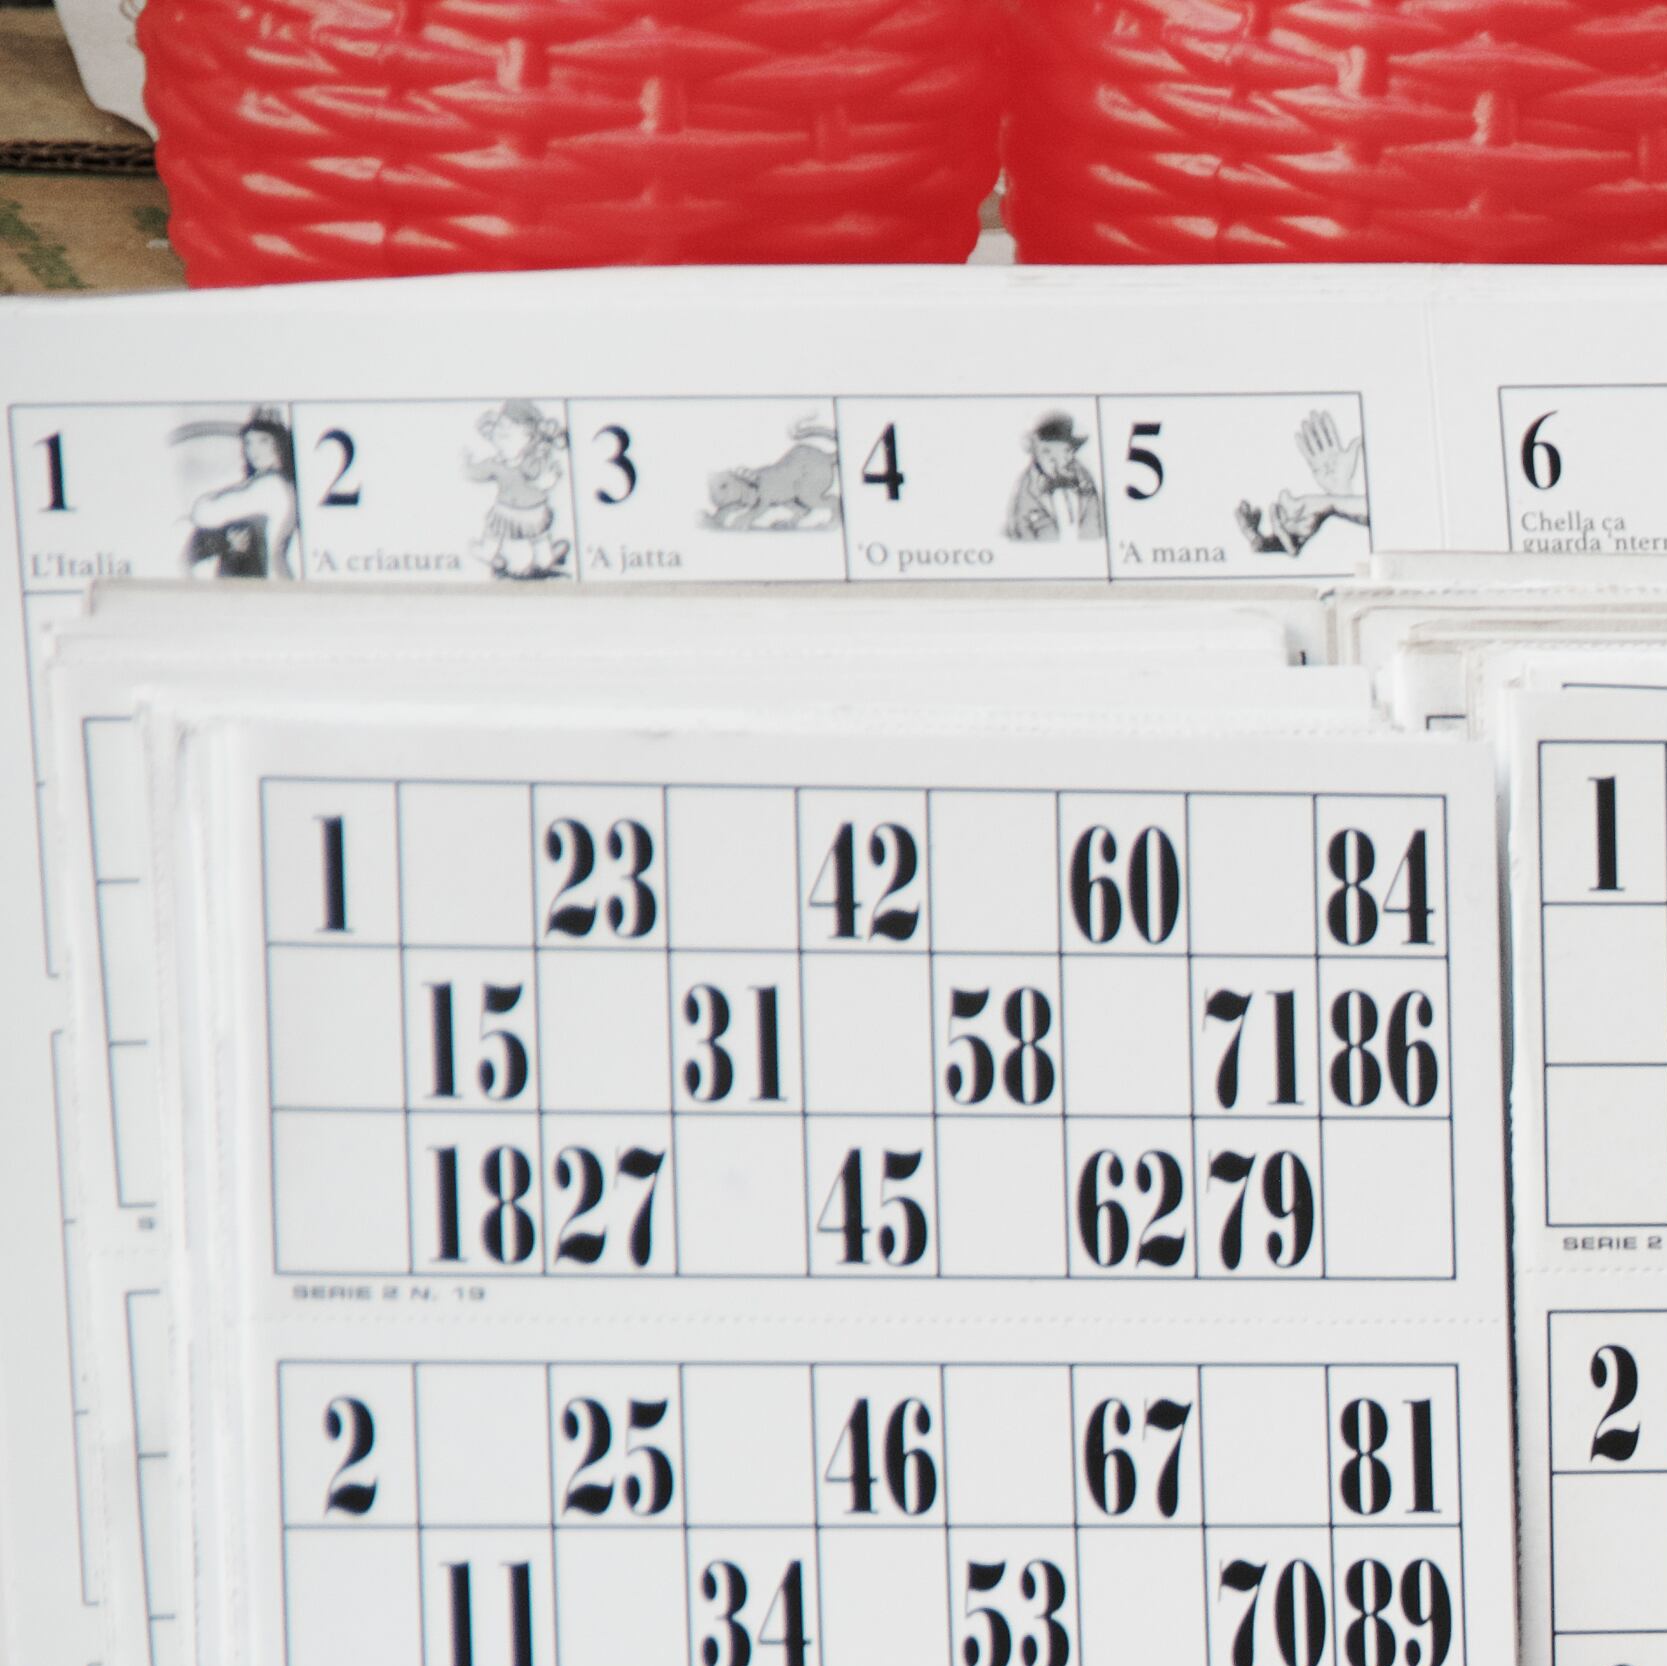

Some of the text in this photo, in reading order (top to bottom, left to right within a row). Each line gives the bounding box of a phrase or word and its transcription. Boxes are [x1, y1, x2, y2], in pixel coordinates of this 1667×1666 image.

[34, 431, 76, 511] 1
[314, 426, 362, 507] 2
[594, 424, 639, 505] 3
[861, 422, 905, 501] 4
[1124, 422, 1164, 500] 5
[1521, 410, 1562, 490] 6
[347, 549, 461, 572] criatura
[616, 546, 683, 574] jatta
[897, 545, 994, 572] puorco
[1151, 546, 1226, 563] mana
[1521, 512, 1597, 533] Chella
[1588, 775, 1625, 892] 1
[316, 813, 1437, 948] 1 23 42 60 84
[1563, 1237, 1636, 1250] SERIE
[322, 1395, 1443, 1519] 2 25 46 67 81
